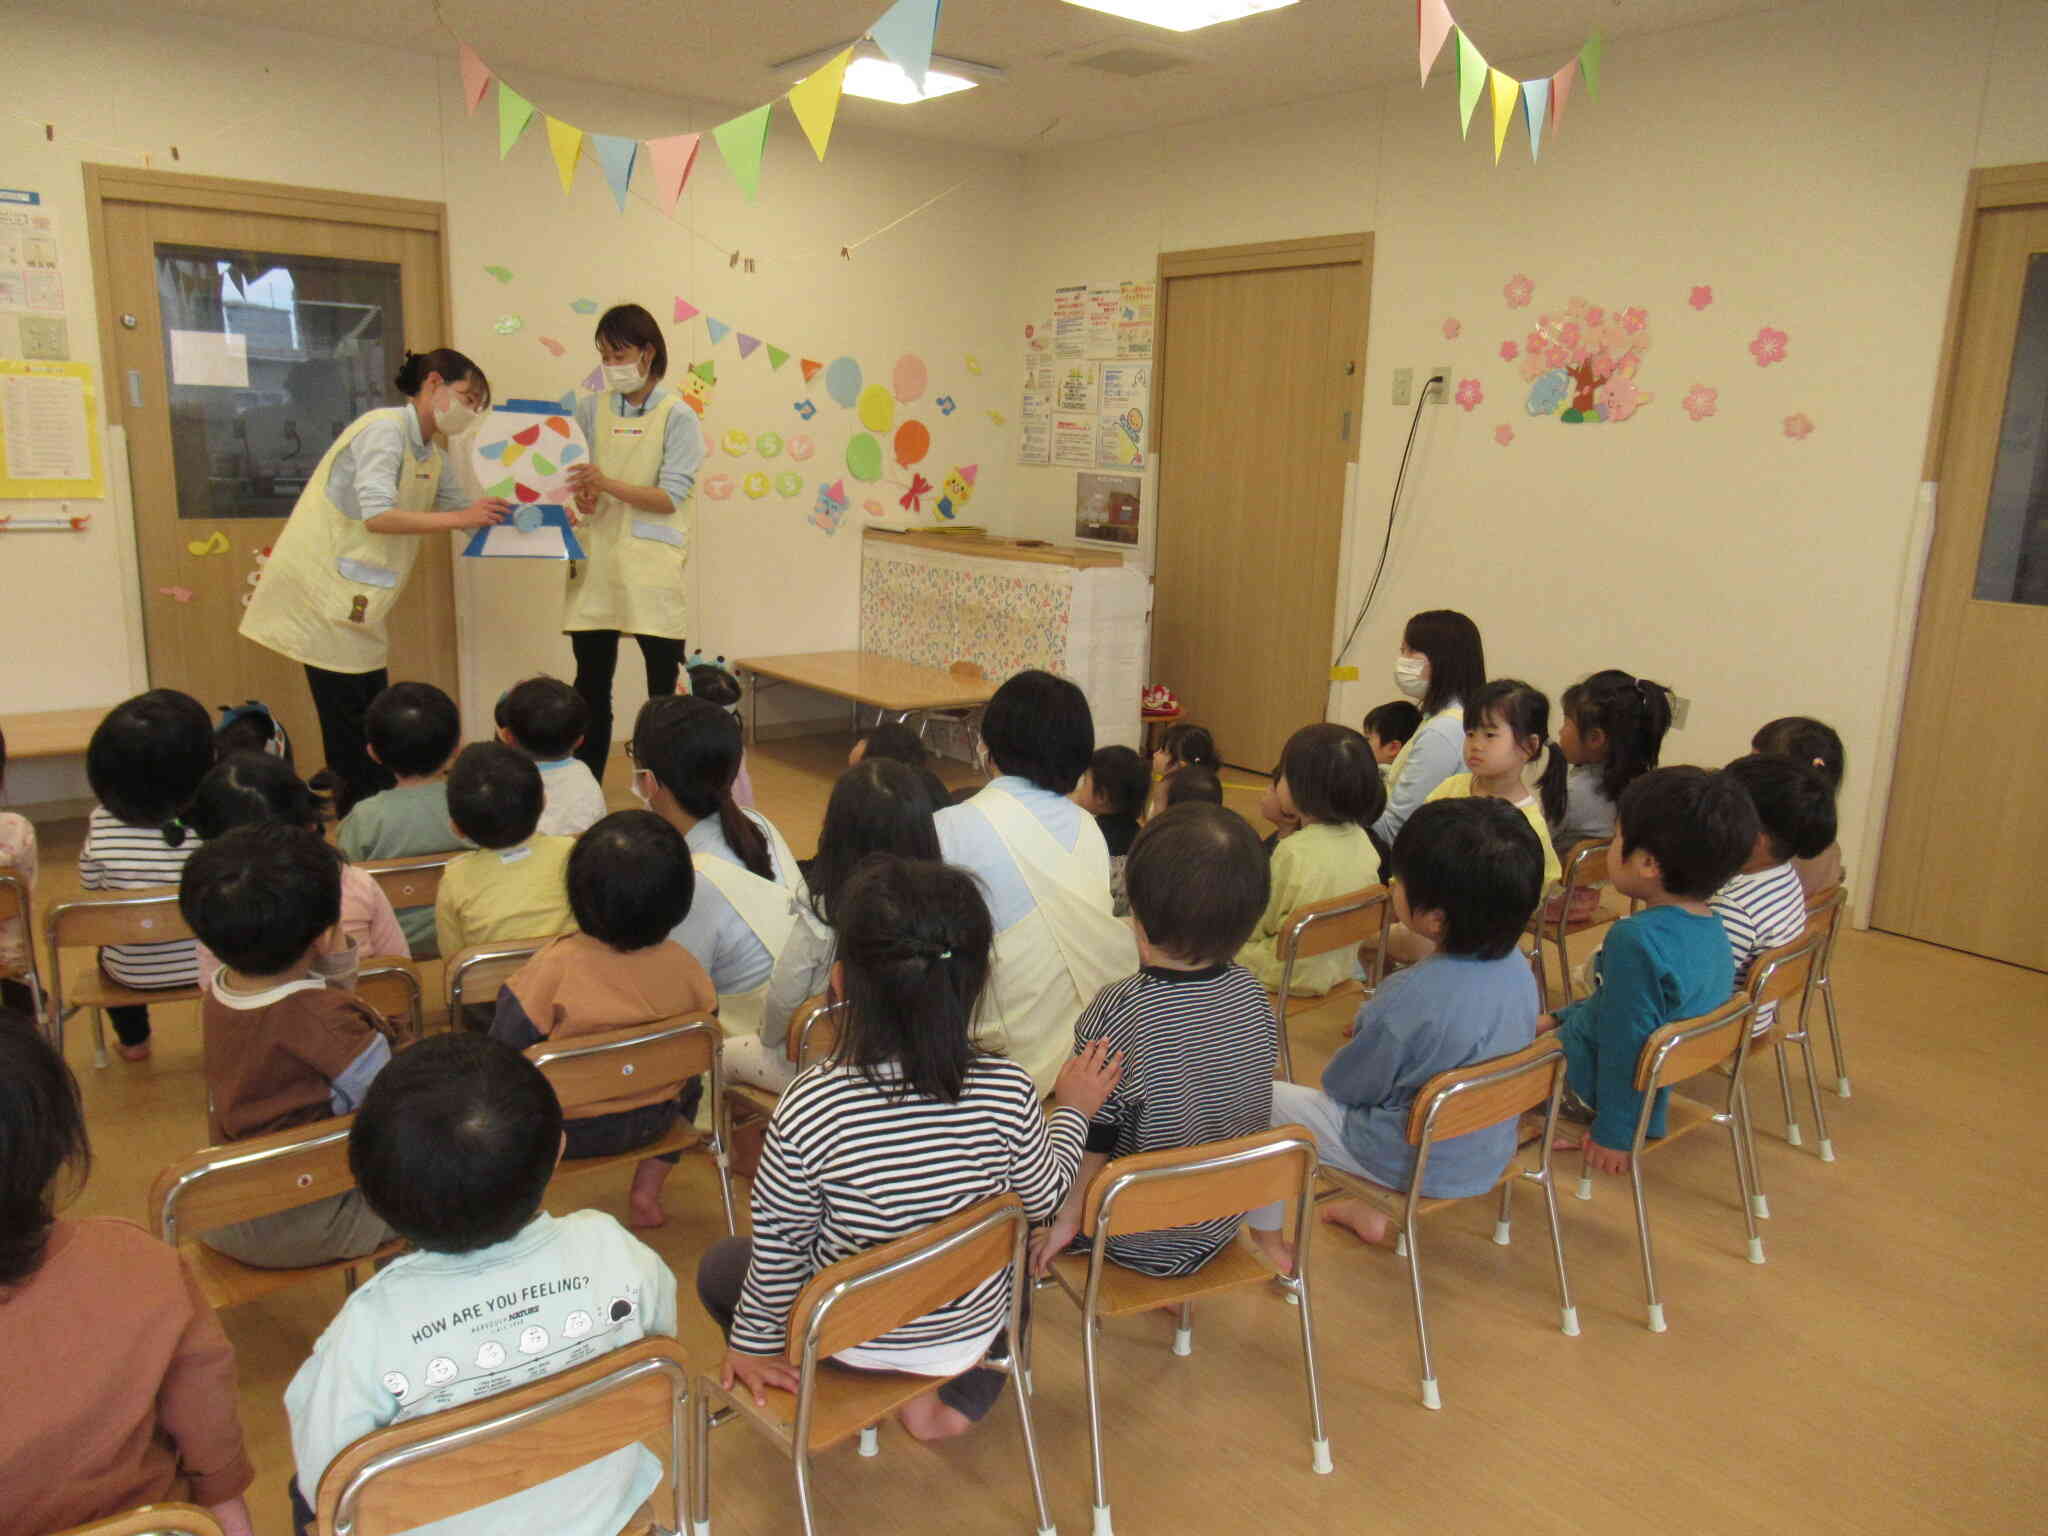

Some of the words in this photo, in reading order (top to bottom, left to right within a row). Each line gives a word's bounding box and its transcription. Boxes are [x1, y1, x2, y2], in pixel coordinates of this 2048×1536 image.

[412, 1318, 447, 1344] HOW
[452, 1304, 483, 1326] ARE
[486, 1292, 518, 1312] YOU
[521, 1276, 590, 1301] FEELING?
